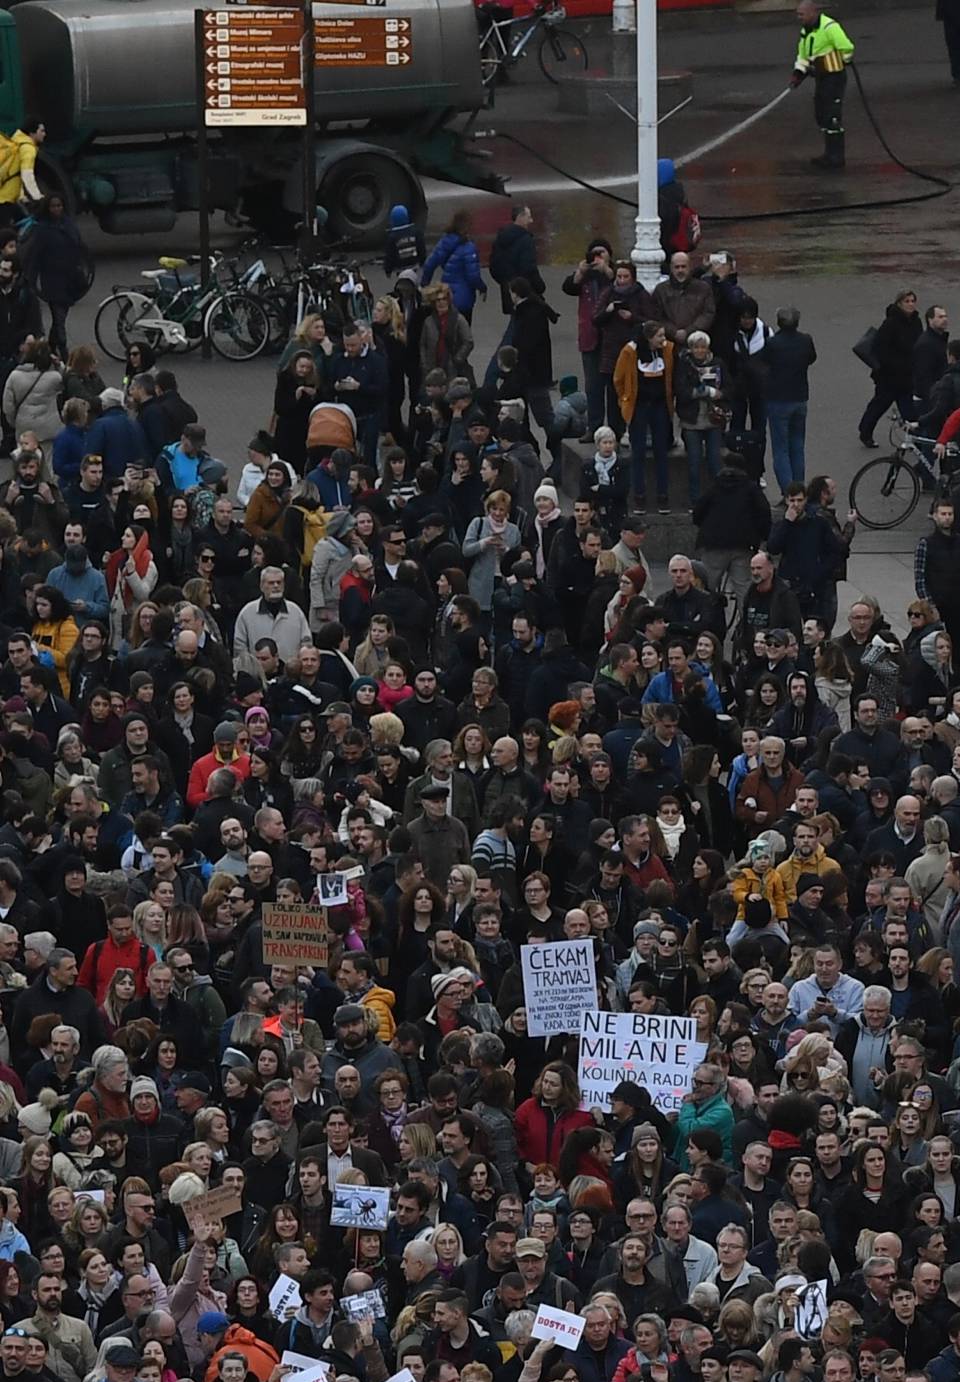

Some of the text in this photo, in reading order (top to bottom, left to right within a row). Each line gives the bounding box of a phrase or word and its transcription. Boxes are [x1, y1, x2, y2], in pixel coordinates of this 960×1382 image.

[264, 913, 326, 929] UZRUJANA
[530, 946, 588, 970] ČEKAM
[531, 968, 591, 987] TRAMVAJ
[584, 1012, 693, 1041] NE BRINI
[582, 1067, 688, 1087] KOLINDA RADI
[537, 1316, 566, 1332] DOSTA
